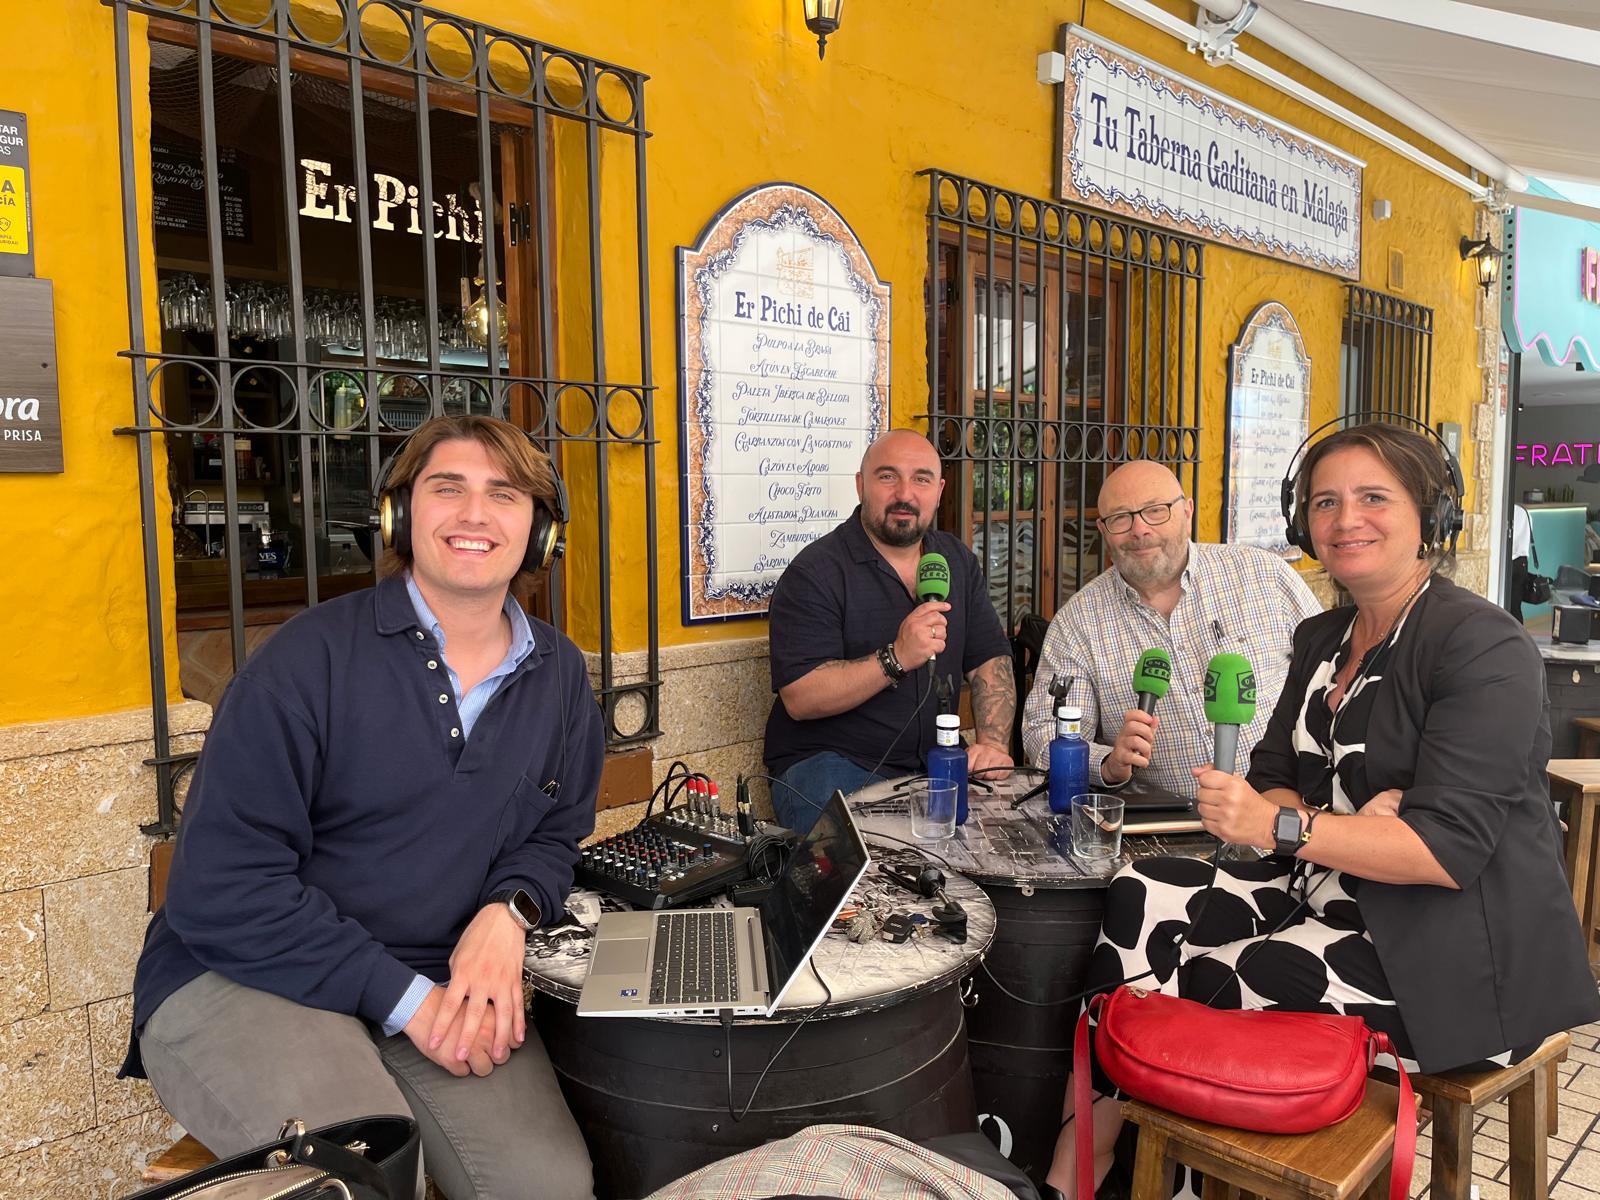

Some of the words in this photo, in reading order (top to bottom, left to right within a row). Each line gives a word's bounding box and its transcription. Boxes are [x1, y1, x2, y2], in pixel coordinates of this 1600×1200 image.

[299, 158, 357, 223] Er
[1090, 92, 1118, 152] Tu
[1124, 106, 1202, 182] Taberna
[1207, 140, 1278, 208] Gaditana
[1281, 183, 1299, 214] en
[1302, 178, 1348, 238] Málaga
[734, 291, 754, 319] Er
[760, 295, 802, 326] Pichi
[808, 306, 824, 328] de
[828, 306, 850, 332] Cái
[4, 429, 42, 441] PRISA
